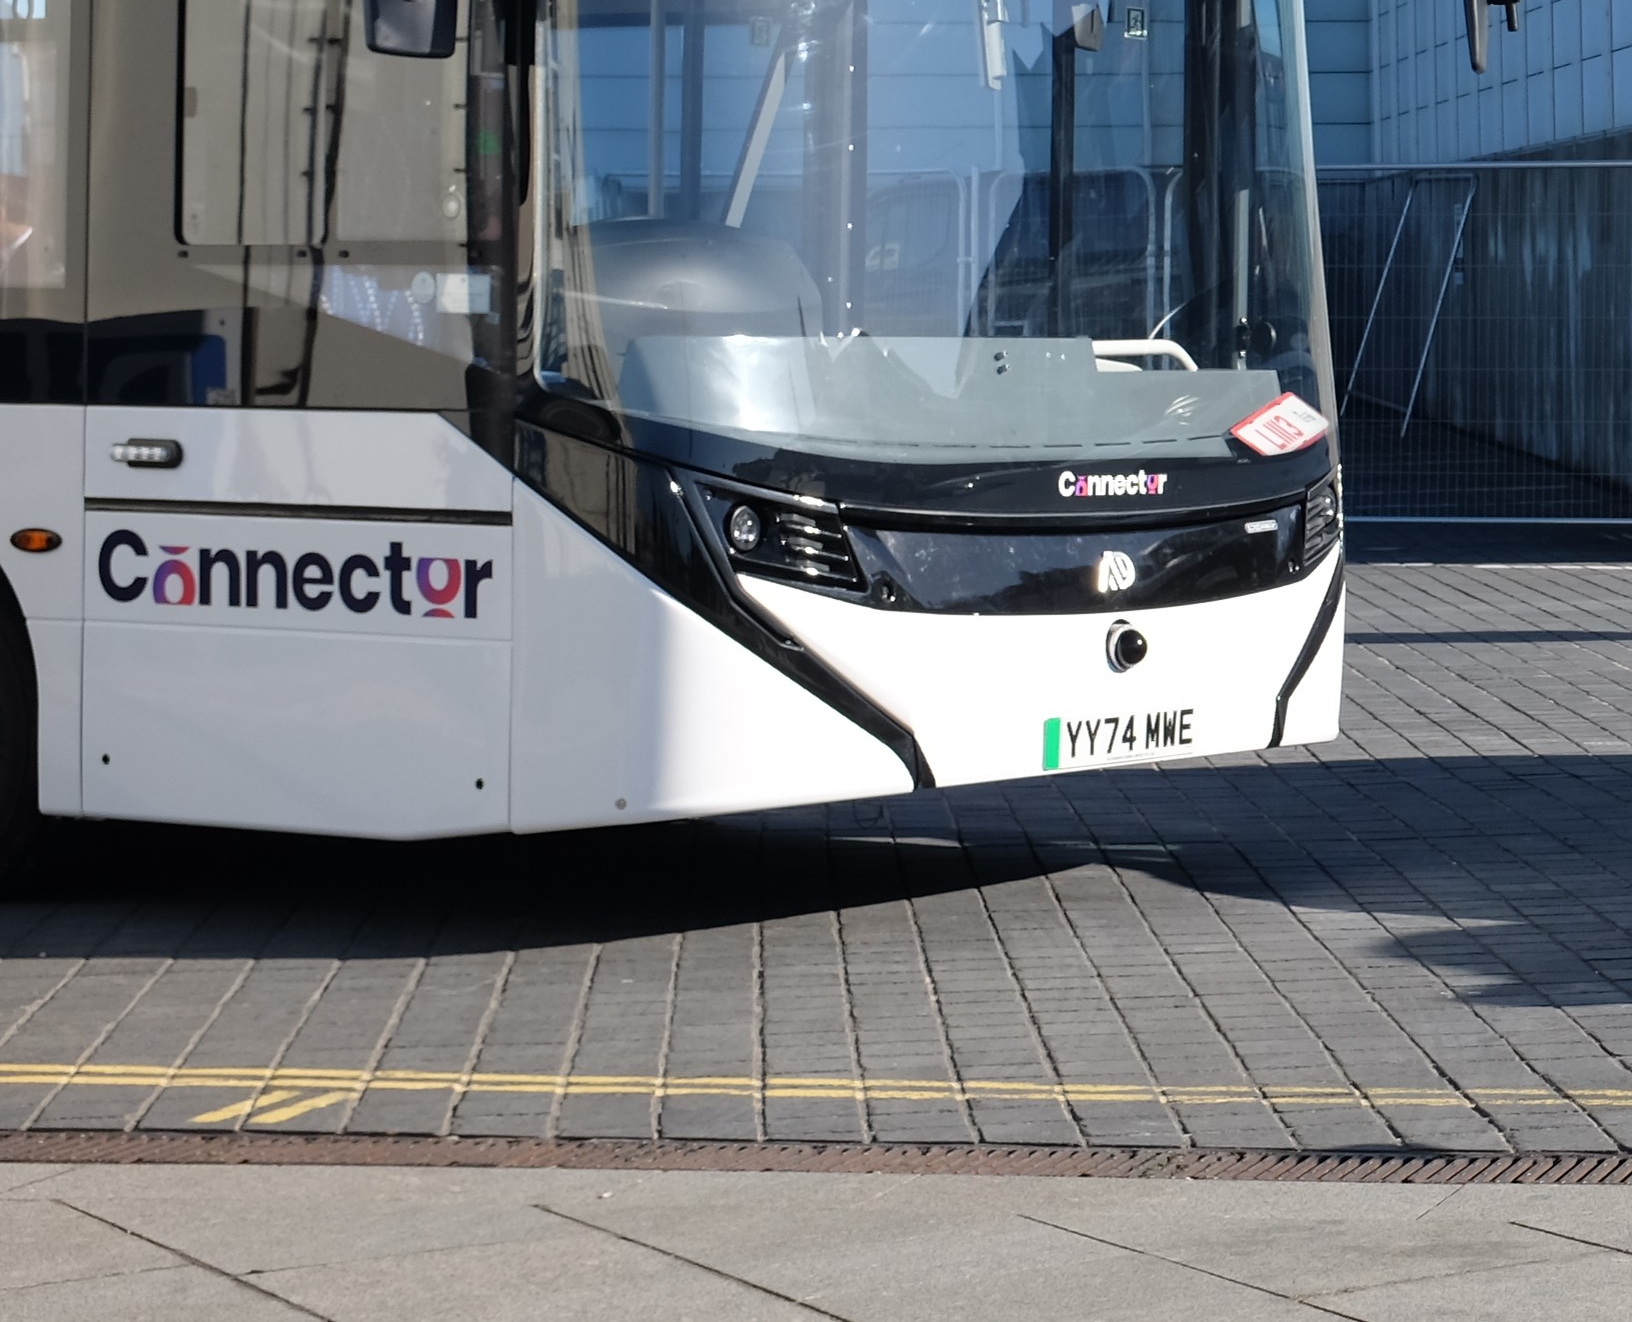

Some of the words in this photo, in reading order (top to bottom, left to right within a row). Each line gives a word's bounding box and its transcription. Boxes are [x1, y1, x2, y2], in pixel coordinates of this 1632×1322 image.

[1058, 469, 1168, 497] Connector
[98, 528, 494, 620] Connector
[1066, 714, 1137, 758] YY74
[1145, 708, 1194, 749] MWE
